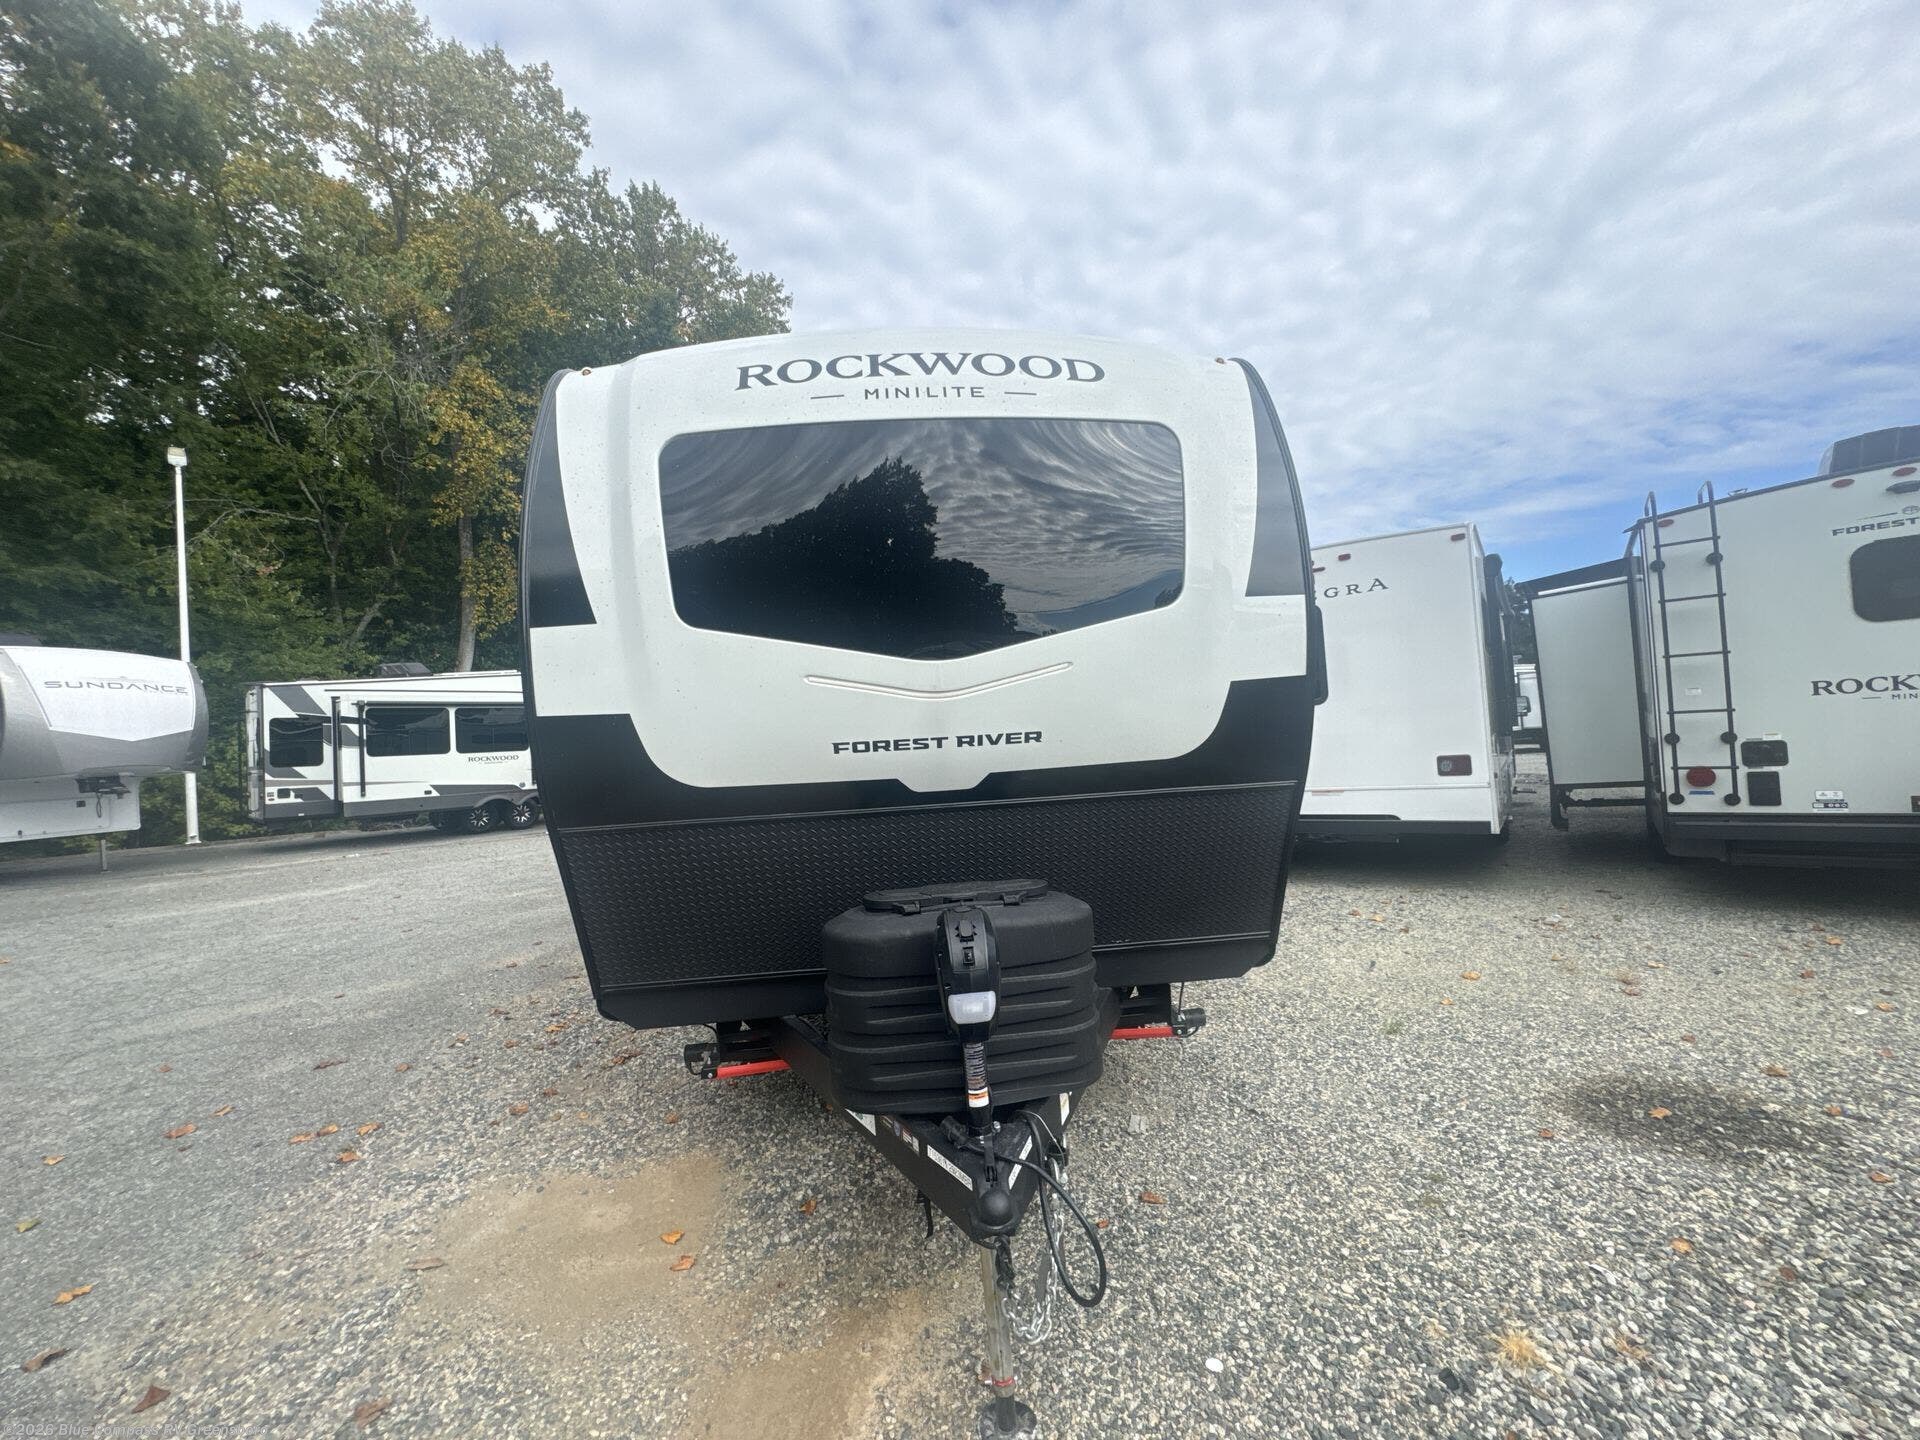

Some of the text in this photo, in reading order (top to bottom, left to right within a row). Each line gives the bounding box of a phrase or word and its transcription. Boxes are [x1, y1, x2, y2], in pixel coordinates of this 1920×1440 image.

[734, 352, 1105, 391] ROCKWOOD
[864, 386, 985, 400] MINILITE
[1314, 578, 1389, 598] GRA
[44, 681, 189, 695] SUNDANCE
[1811, 674, 1920, 696] ROCK
[832, 731, 1042, 754] FOREST RIVER
